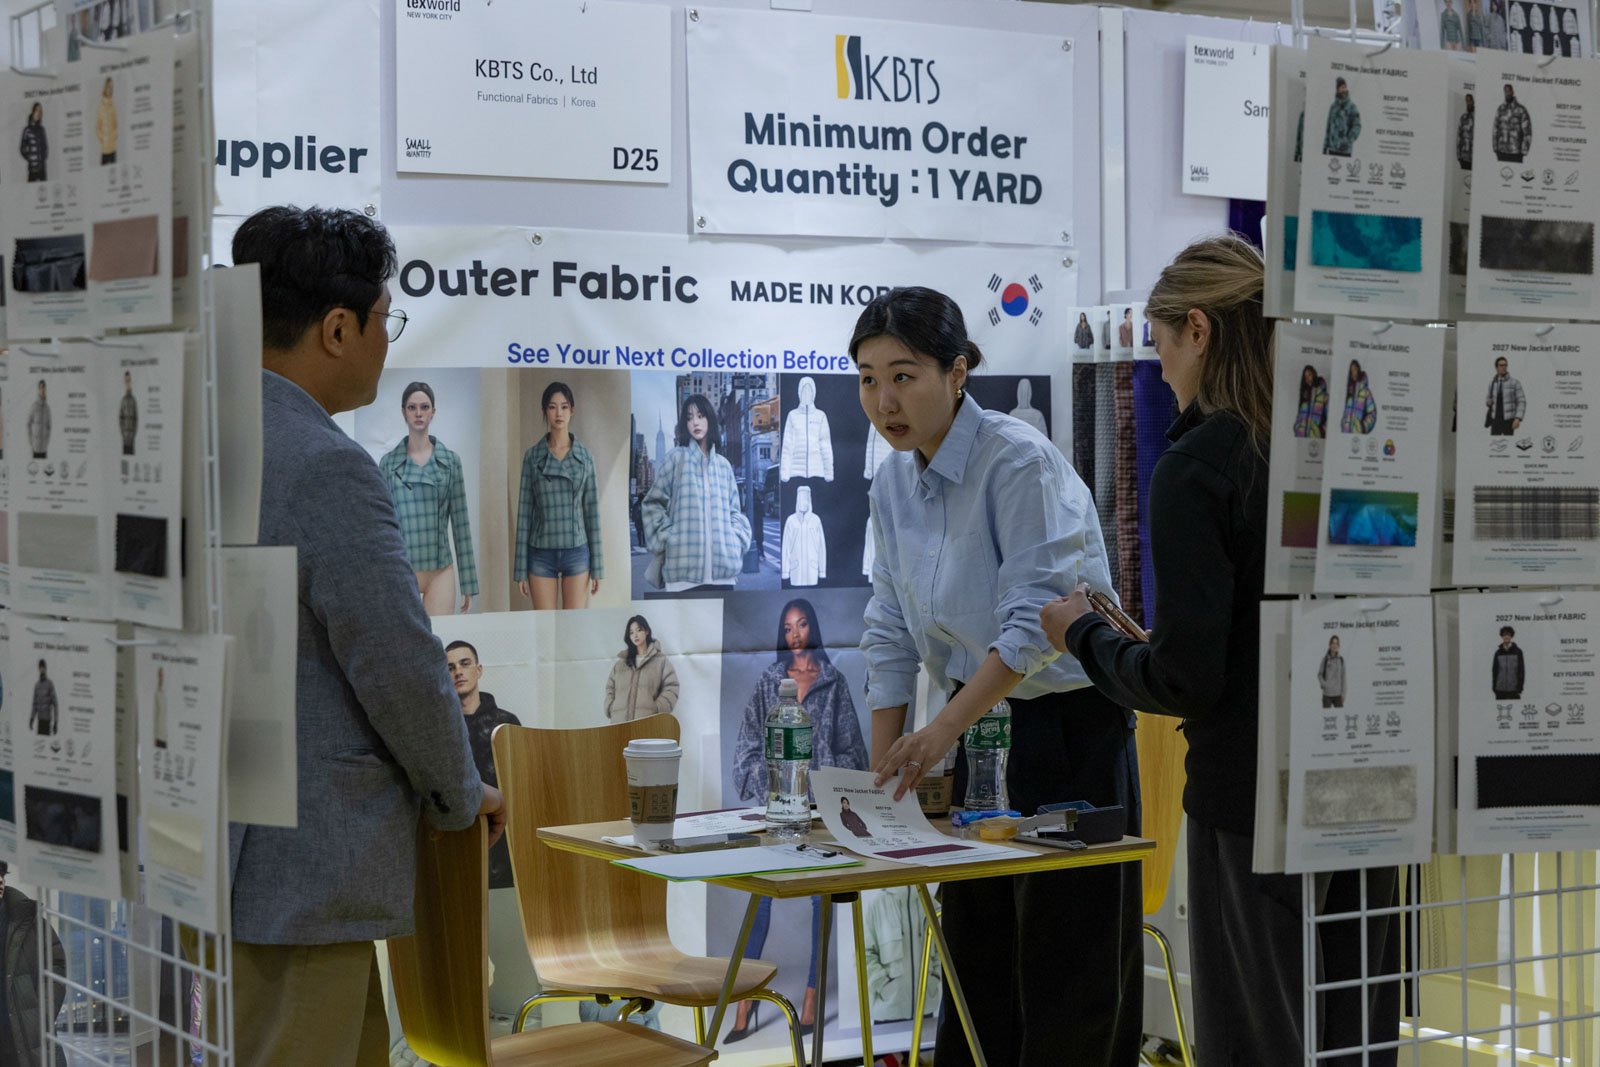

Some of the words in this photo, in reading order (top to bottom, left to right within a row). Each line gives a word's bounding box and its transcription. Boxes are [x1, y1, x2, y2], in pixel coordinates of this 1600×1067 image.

[406, 0, 460, 12] texworld
[1194, 45, 1234, 60] texworld
[475, 58, 524, 80] KBTS
[530, 62, 564, 85] Co.,
[571, 65, 598, 84] Ltd
[866, 54, 940, 104] KBTS
[477, 91, 524, 104] Functional
[526, 93, 558, 106] Fabrics
[571, 96, 596, 108] Korea
[406, 138, 432, 150] SMALL
[744, 112, 912, 151] Minimum
[922, 121, 1028, 160] Order
[613, 147, 659, 171] D25
[727, 158, 898, 207] Quantity
[948, 169, 1043, 205] YARD
[399, 258, 539, 298] Outer
[552, 261, 700, 304] Fabric
[730, 280, 802, 304] MADE
[810, 282, 833, 306] IN
[507, 342, 550, 364] See
[556, 344, 610, 366] Your
[616, 346, 664, 368] Next
[670, 346, 778, 370] Collection
[784, 350, 850, 371] Before
[1529, 344, 1552, 353] Jacket
[1553, 345, 1580, 353] FABRIC
[1496, 614, 1512, 622] 2027
[1533, 613, 1557, 621] Jacket
